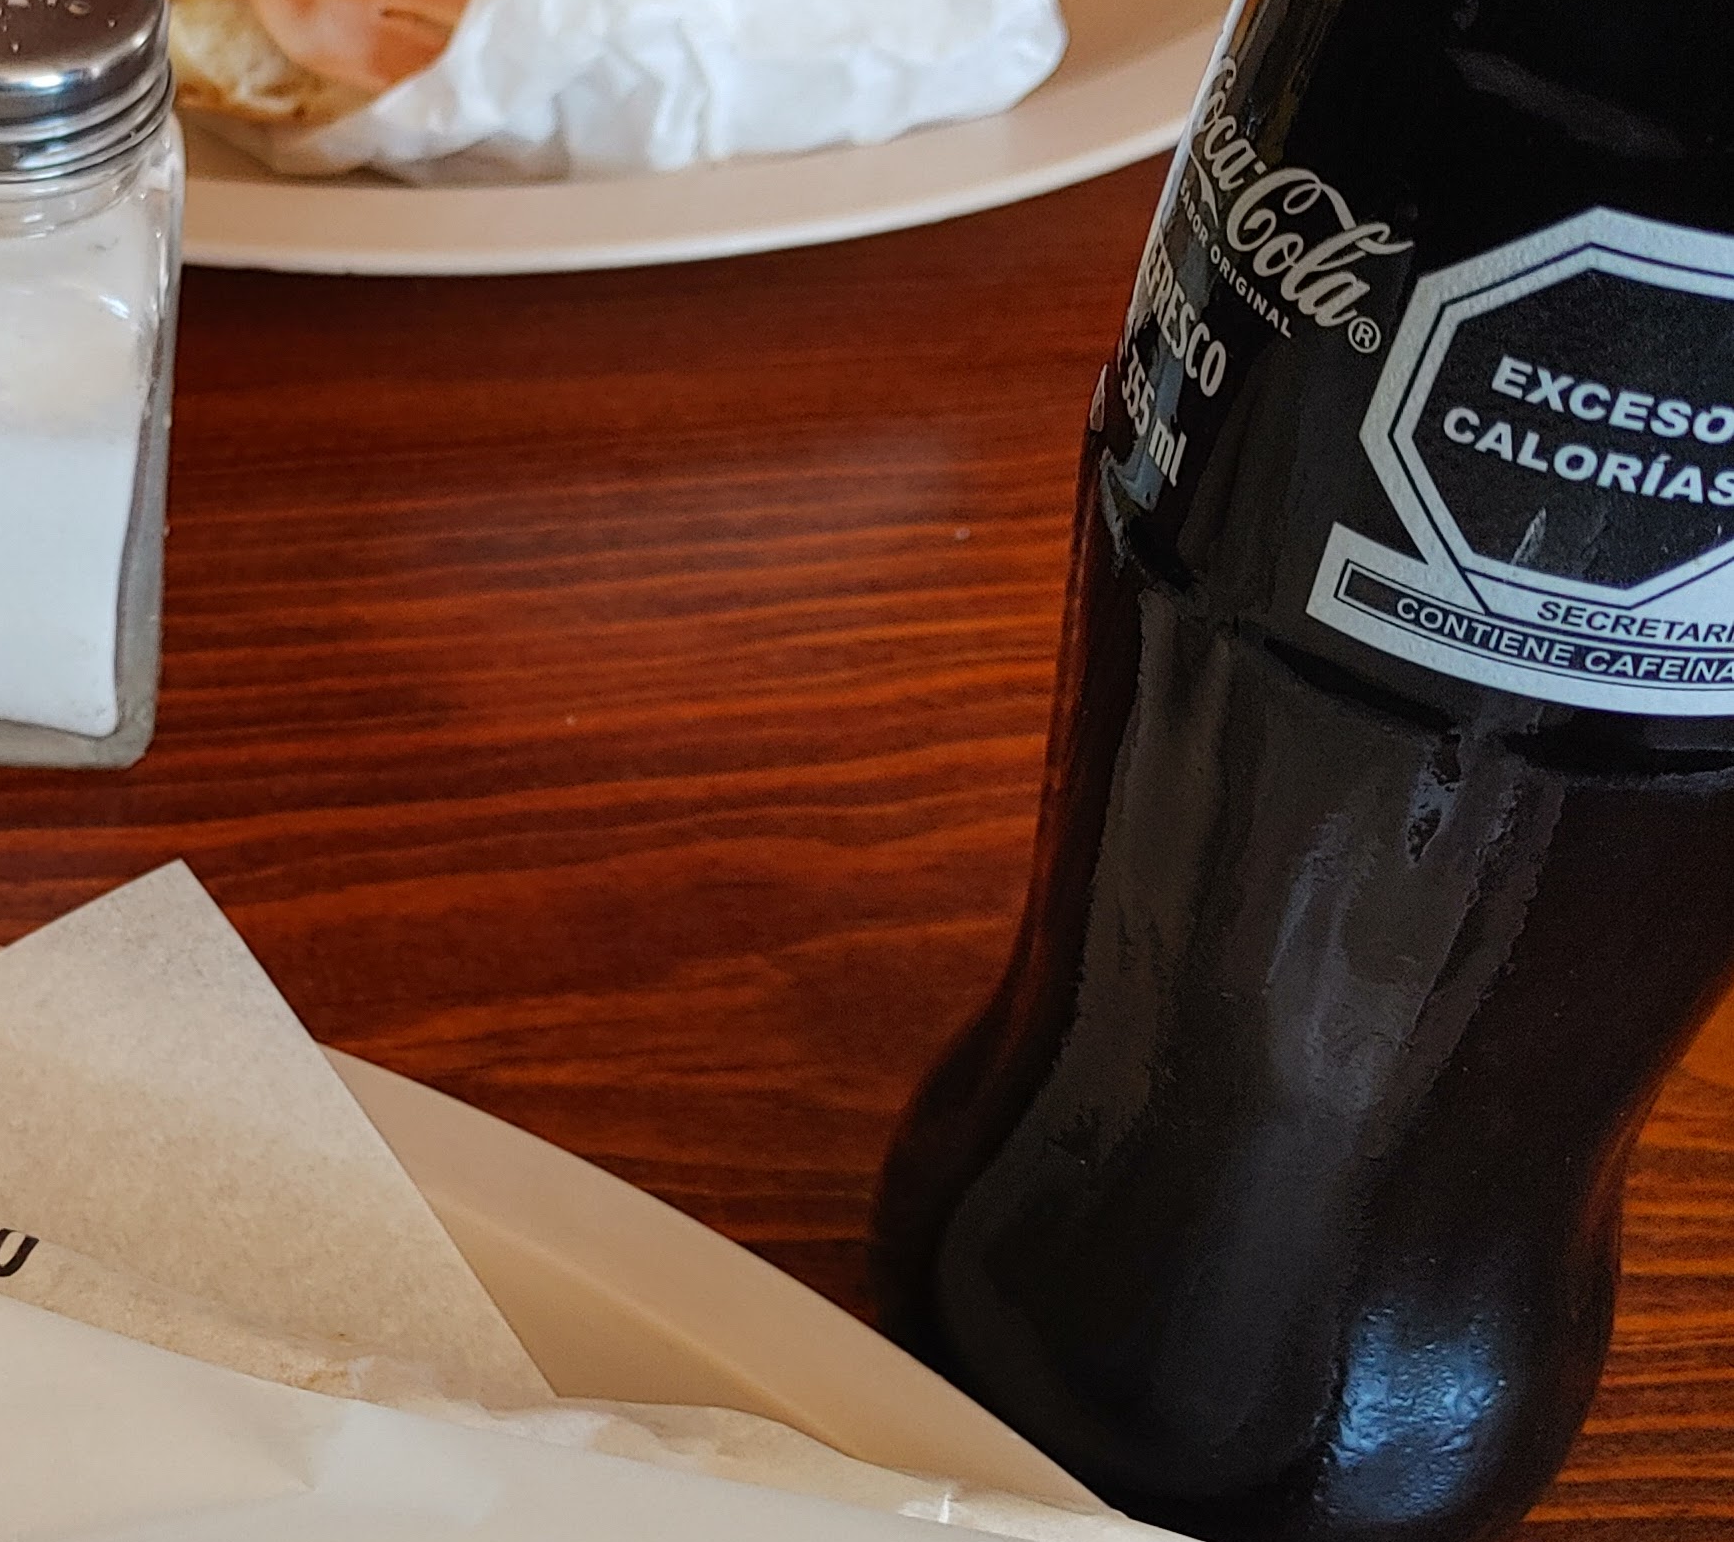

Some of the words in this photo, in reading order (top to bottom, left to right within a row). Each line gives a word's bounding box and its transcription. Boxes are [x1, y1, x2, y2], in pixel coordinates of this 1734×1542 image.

[1209, 244, 1293, 339] ORIGINAL
[1491, 355, 1734, 445] EXCESO
[1148, 416, 1188, 488] ml
[1442, 408, 1734, 507] CALORÍAS
[1397, 597, 1575, 666] CONTIENE
[1584, 649, 1734, 683] CAFEÍNA
